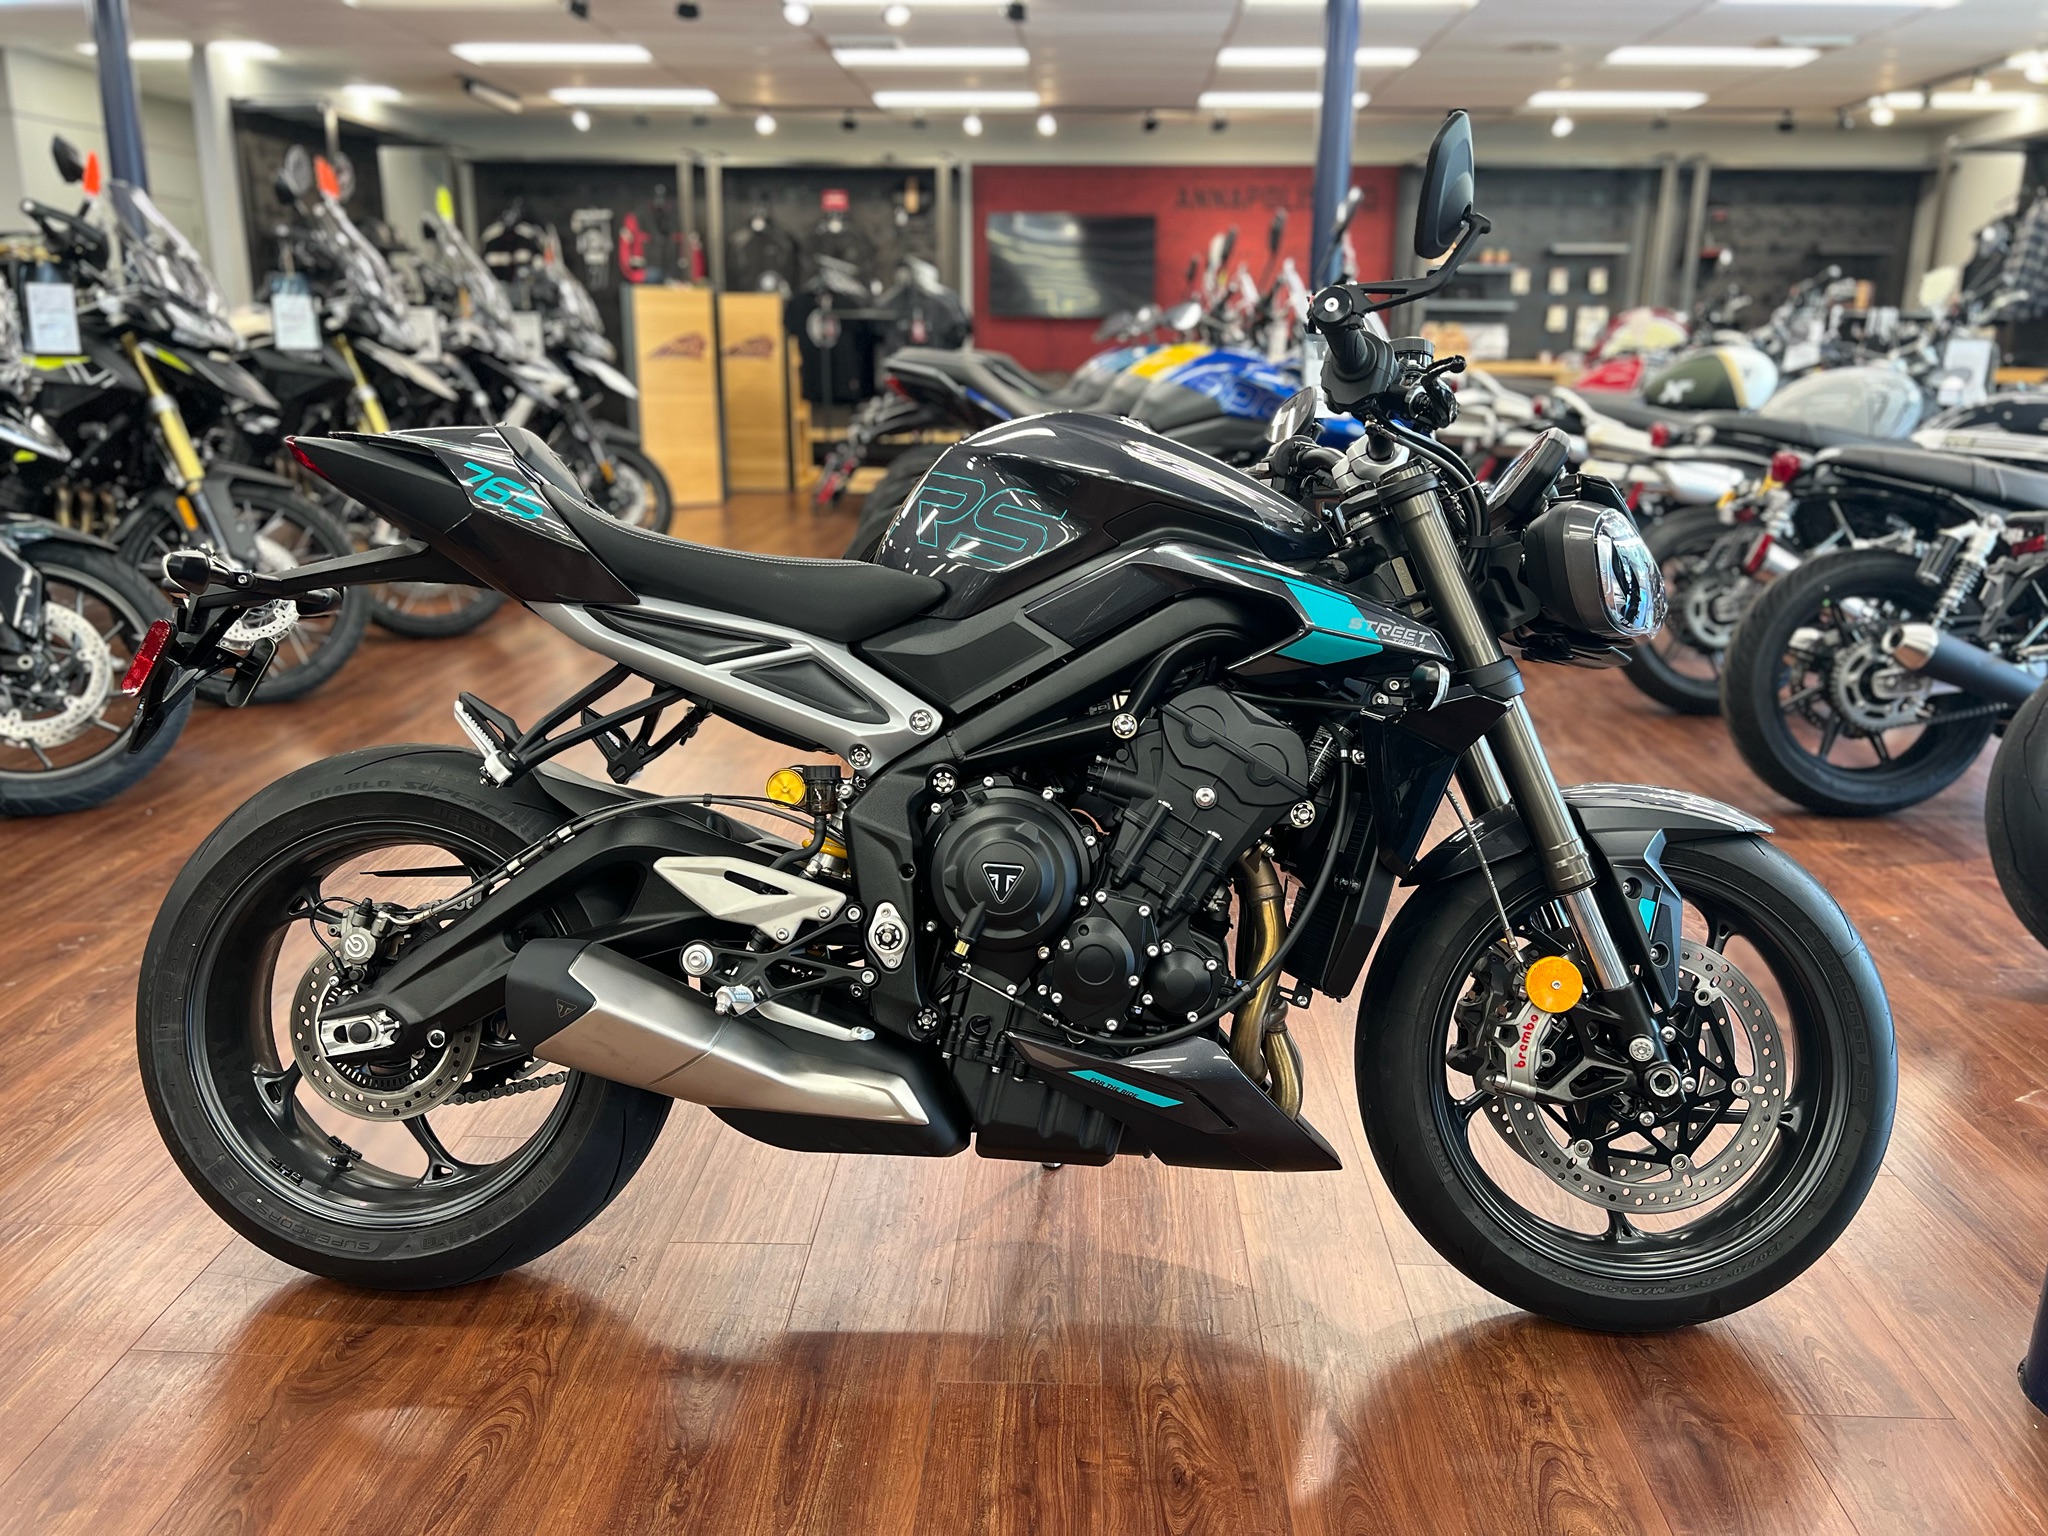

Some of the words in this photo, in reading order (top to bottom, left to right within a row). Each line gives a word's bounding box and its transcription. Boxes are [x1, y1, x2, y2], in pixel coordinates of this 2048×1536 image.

[888, 471, 1068, 566] RS
[1348, 617, 1431, 643] STREET
[309, 779, 391, 799] DIABLO
[1514, 1014, 1539, 1069] brembo
